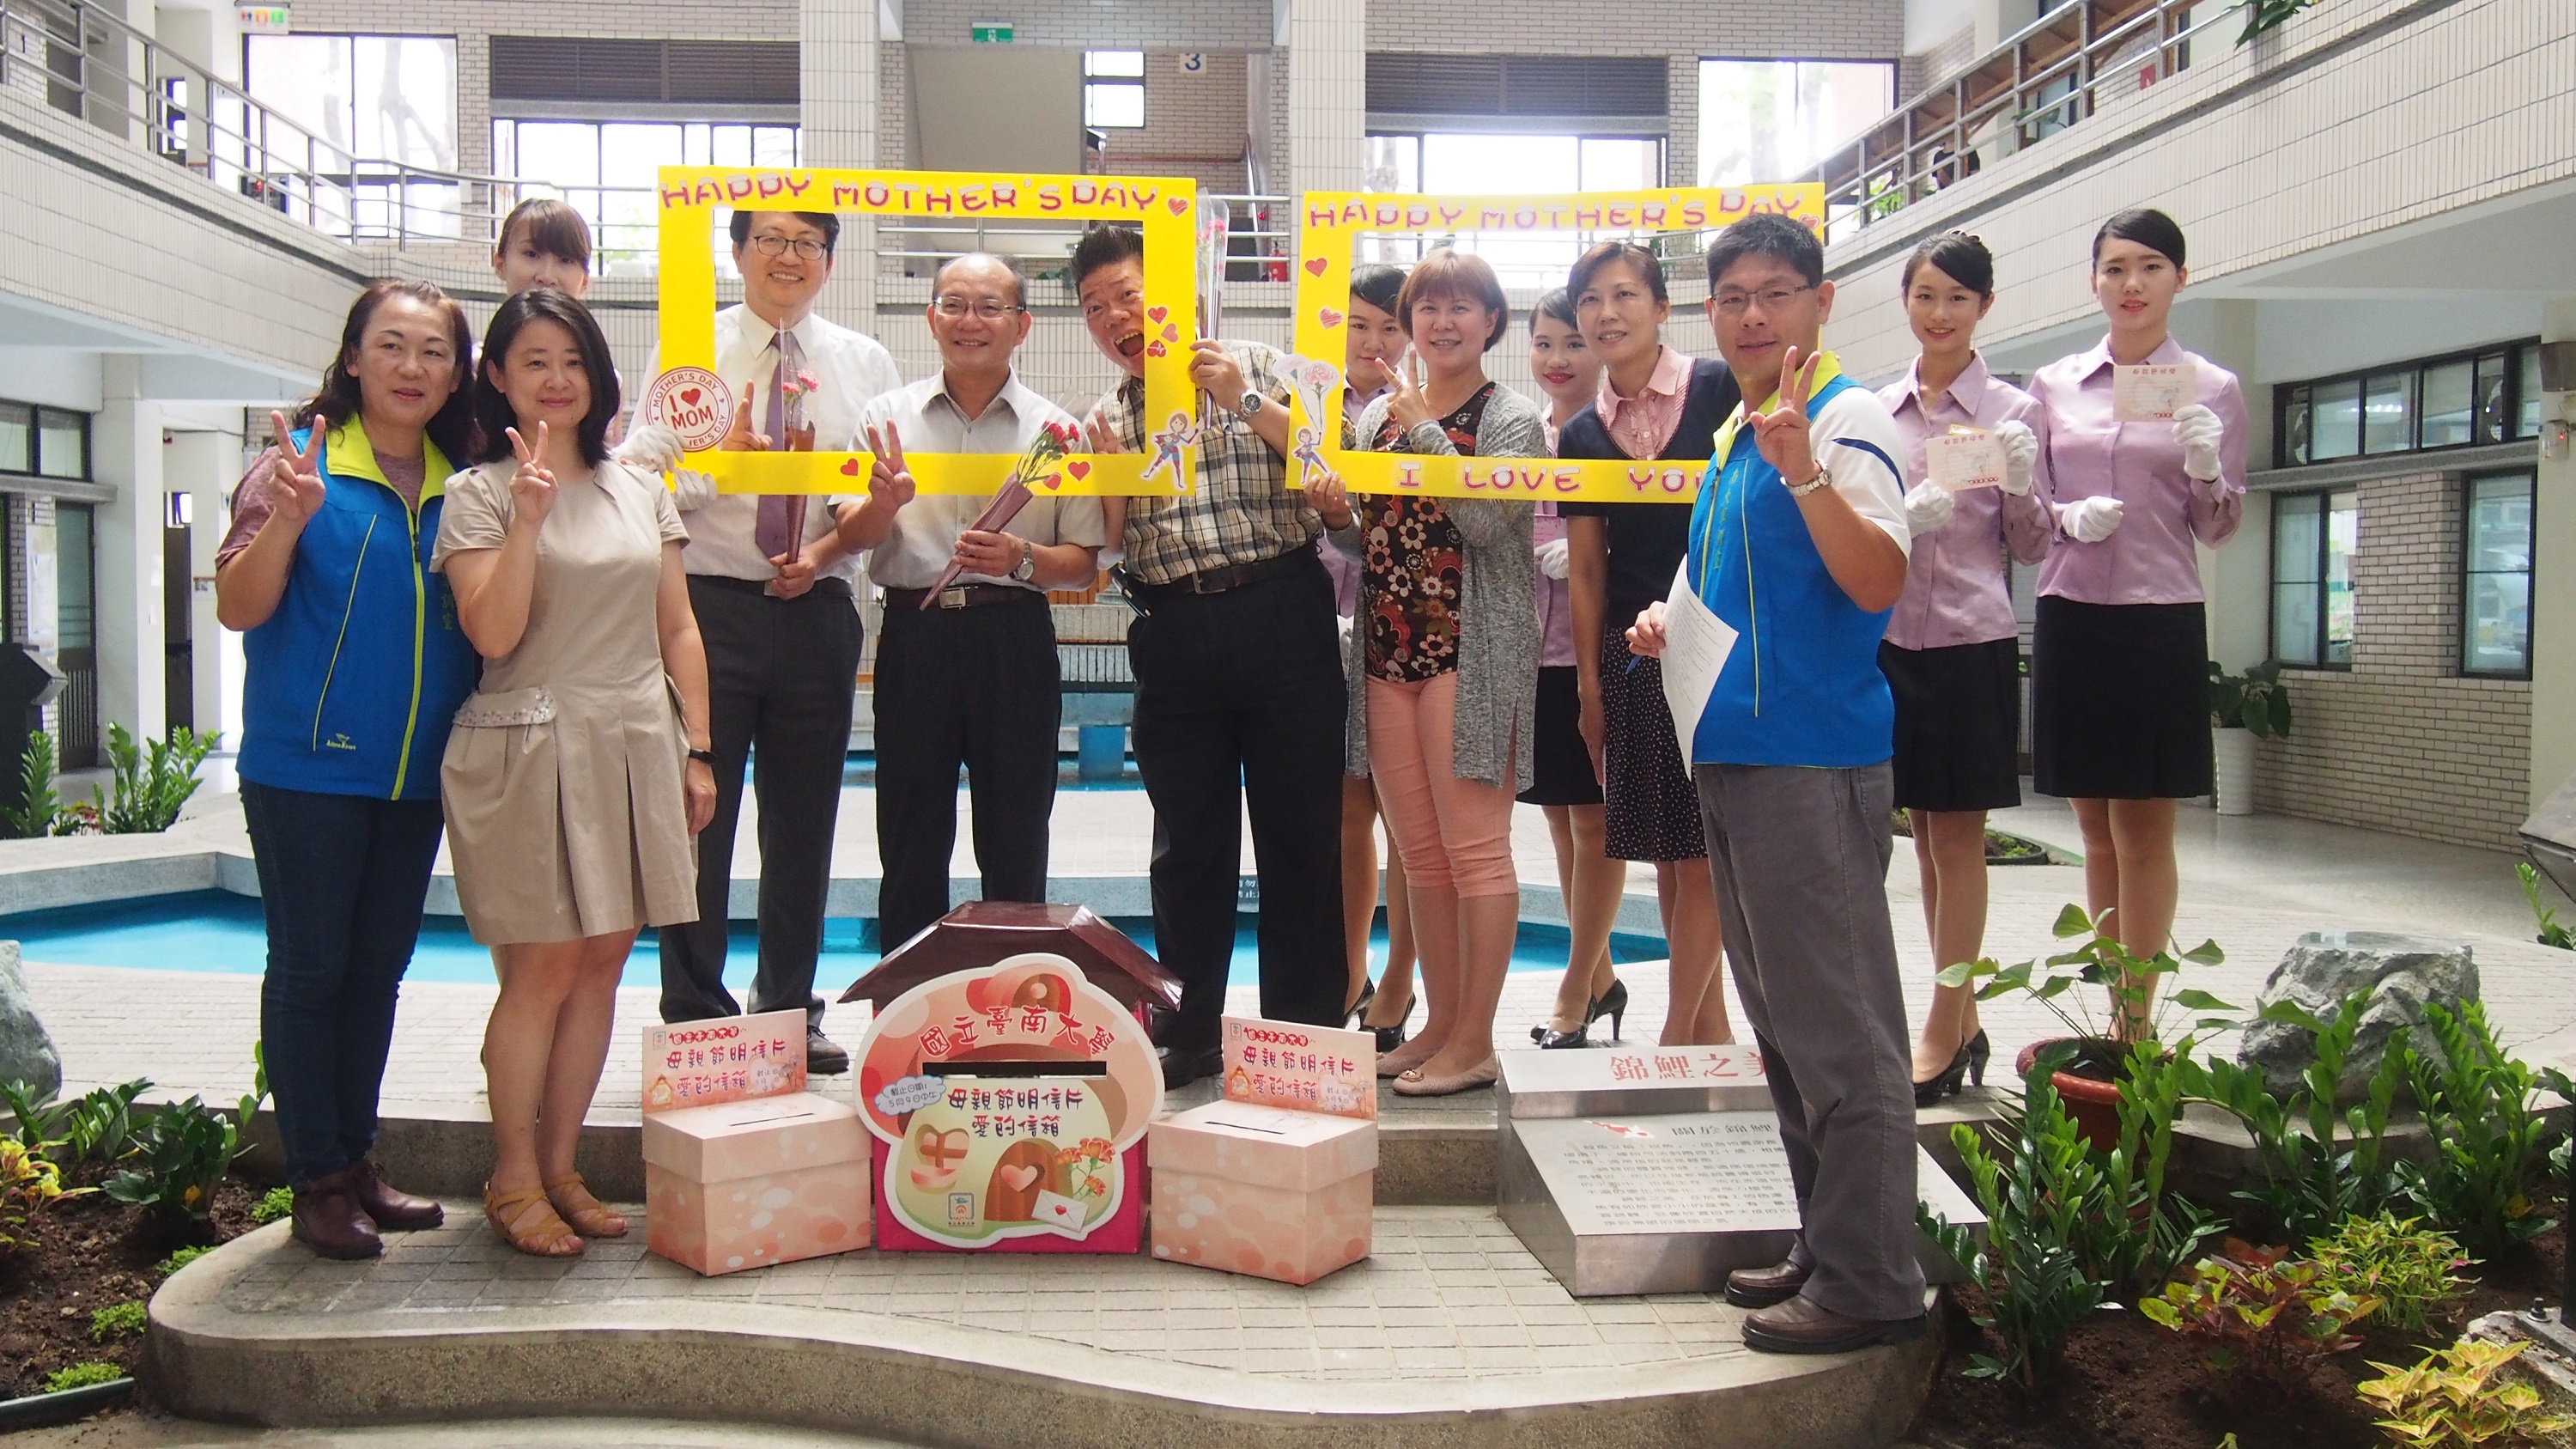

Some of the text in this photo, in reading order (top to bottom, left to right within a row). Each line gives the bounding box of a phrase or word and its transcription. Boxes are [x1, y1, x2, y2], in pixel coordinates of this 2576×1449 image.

[1185, 53, 1200, 70] 3
[659, 170, 1158, 213] HAPPY MOTHER'S DAY
[1309, 188, 1802, 230] HAPPY MOTHER'S DAY
[653, 372, 719, 408] MOTHER'S DAY
[669, 394, 677, 412] I
[671, 405, 714, 430] MOM
[714, 414, 726, 433] DAY
[1399, 462, 1701, 494] I LOVE YO
[919, 1005, 1115, 1056] 國立臺南大學
[666, 1038, 787, 1070] 母親節明信片
[1243, 1045, 1355, 1077] 母親節明信片
[677, 1069, 748, 1098] 愛的信箱
[1253, 1073, 1319, 1101] 愛的信箱
[947, 1087, 1084, 1111] 母親節明信片
[971, 1114, 1062, 1139] 愛的信箱
